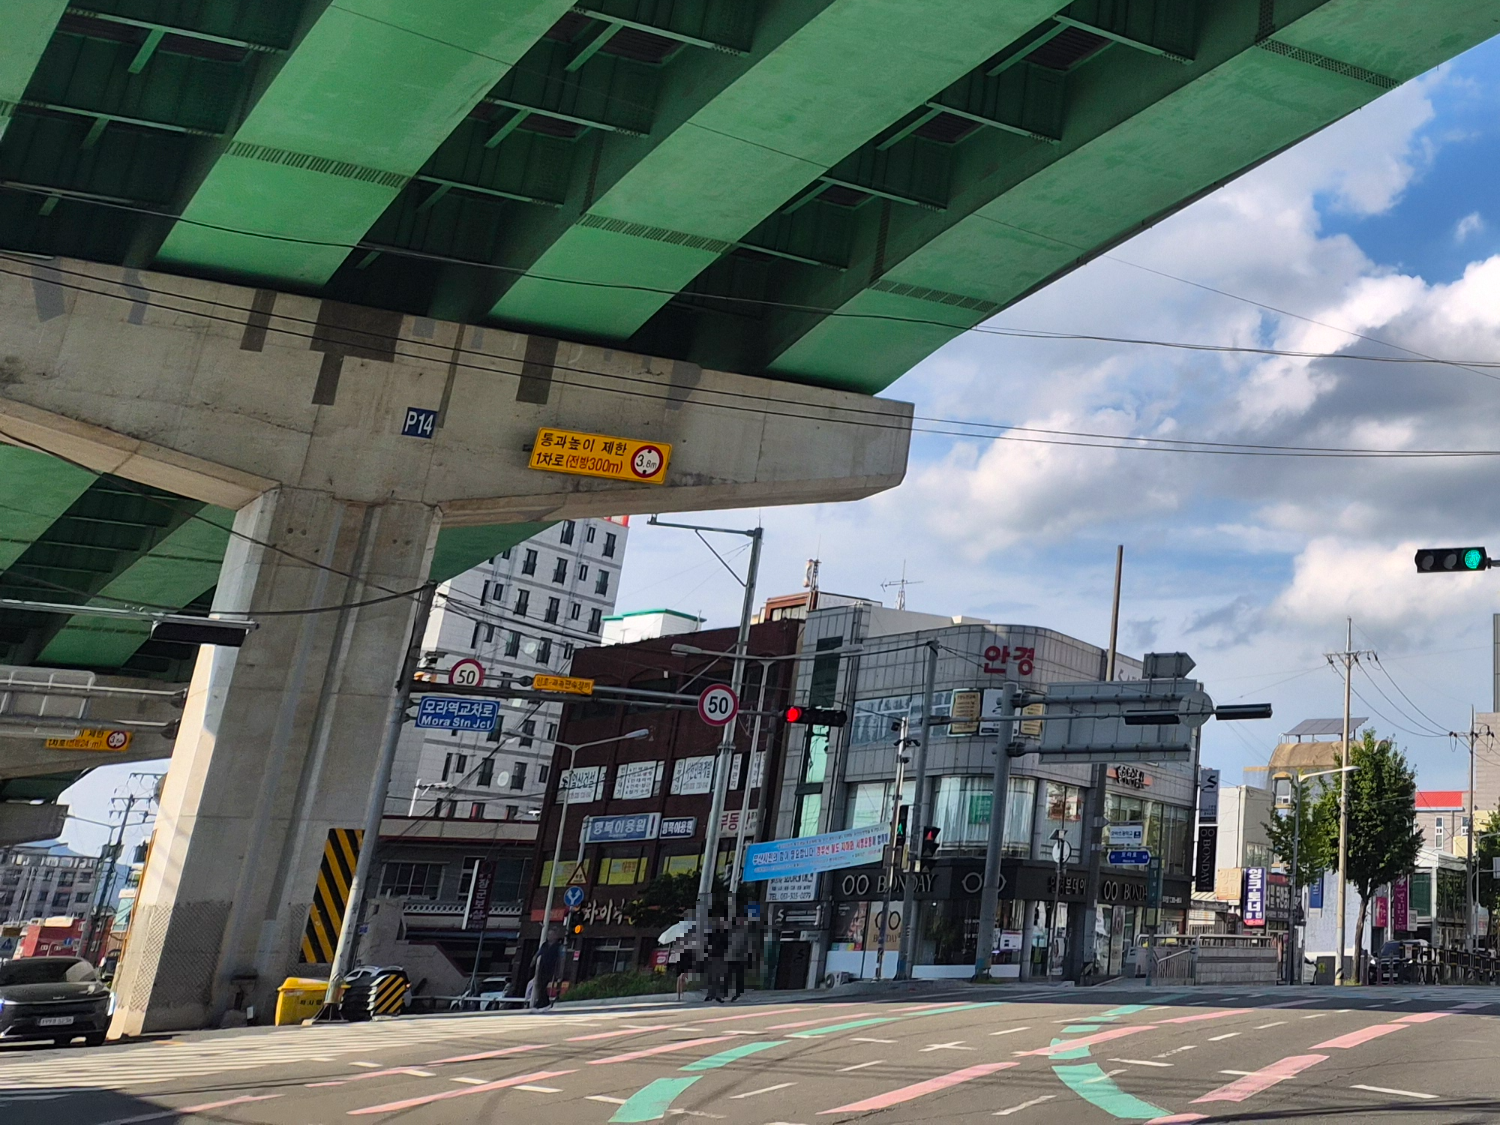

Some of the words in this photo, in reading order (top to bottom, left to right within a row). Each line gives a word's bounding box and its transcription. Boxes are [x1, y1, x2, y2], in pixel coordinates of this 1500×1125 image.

[404, 412, 434, 435] P14
[540, 433, 595, 453] 통과높이
[601, 441, 627, 457] 제한
[535, 452, 565, 466] 1차로
[565, 454, 623, 474] (전방300m)
[984, 645, 1035, 676] 안경
[456, 669, 476, 685] 50
[422, 700, 494, 718] 모라역교차로
[708, 695, 729, 715] 50
[421, 715, 450, 727] Mora
[452, 715, 471, 728] Stn
[473, 717, 491, 729] Jct
[593, 818, 647, 835] 행복이용원
[1201, 838, 1211, 885] BONDAY
